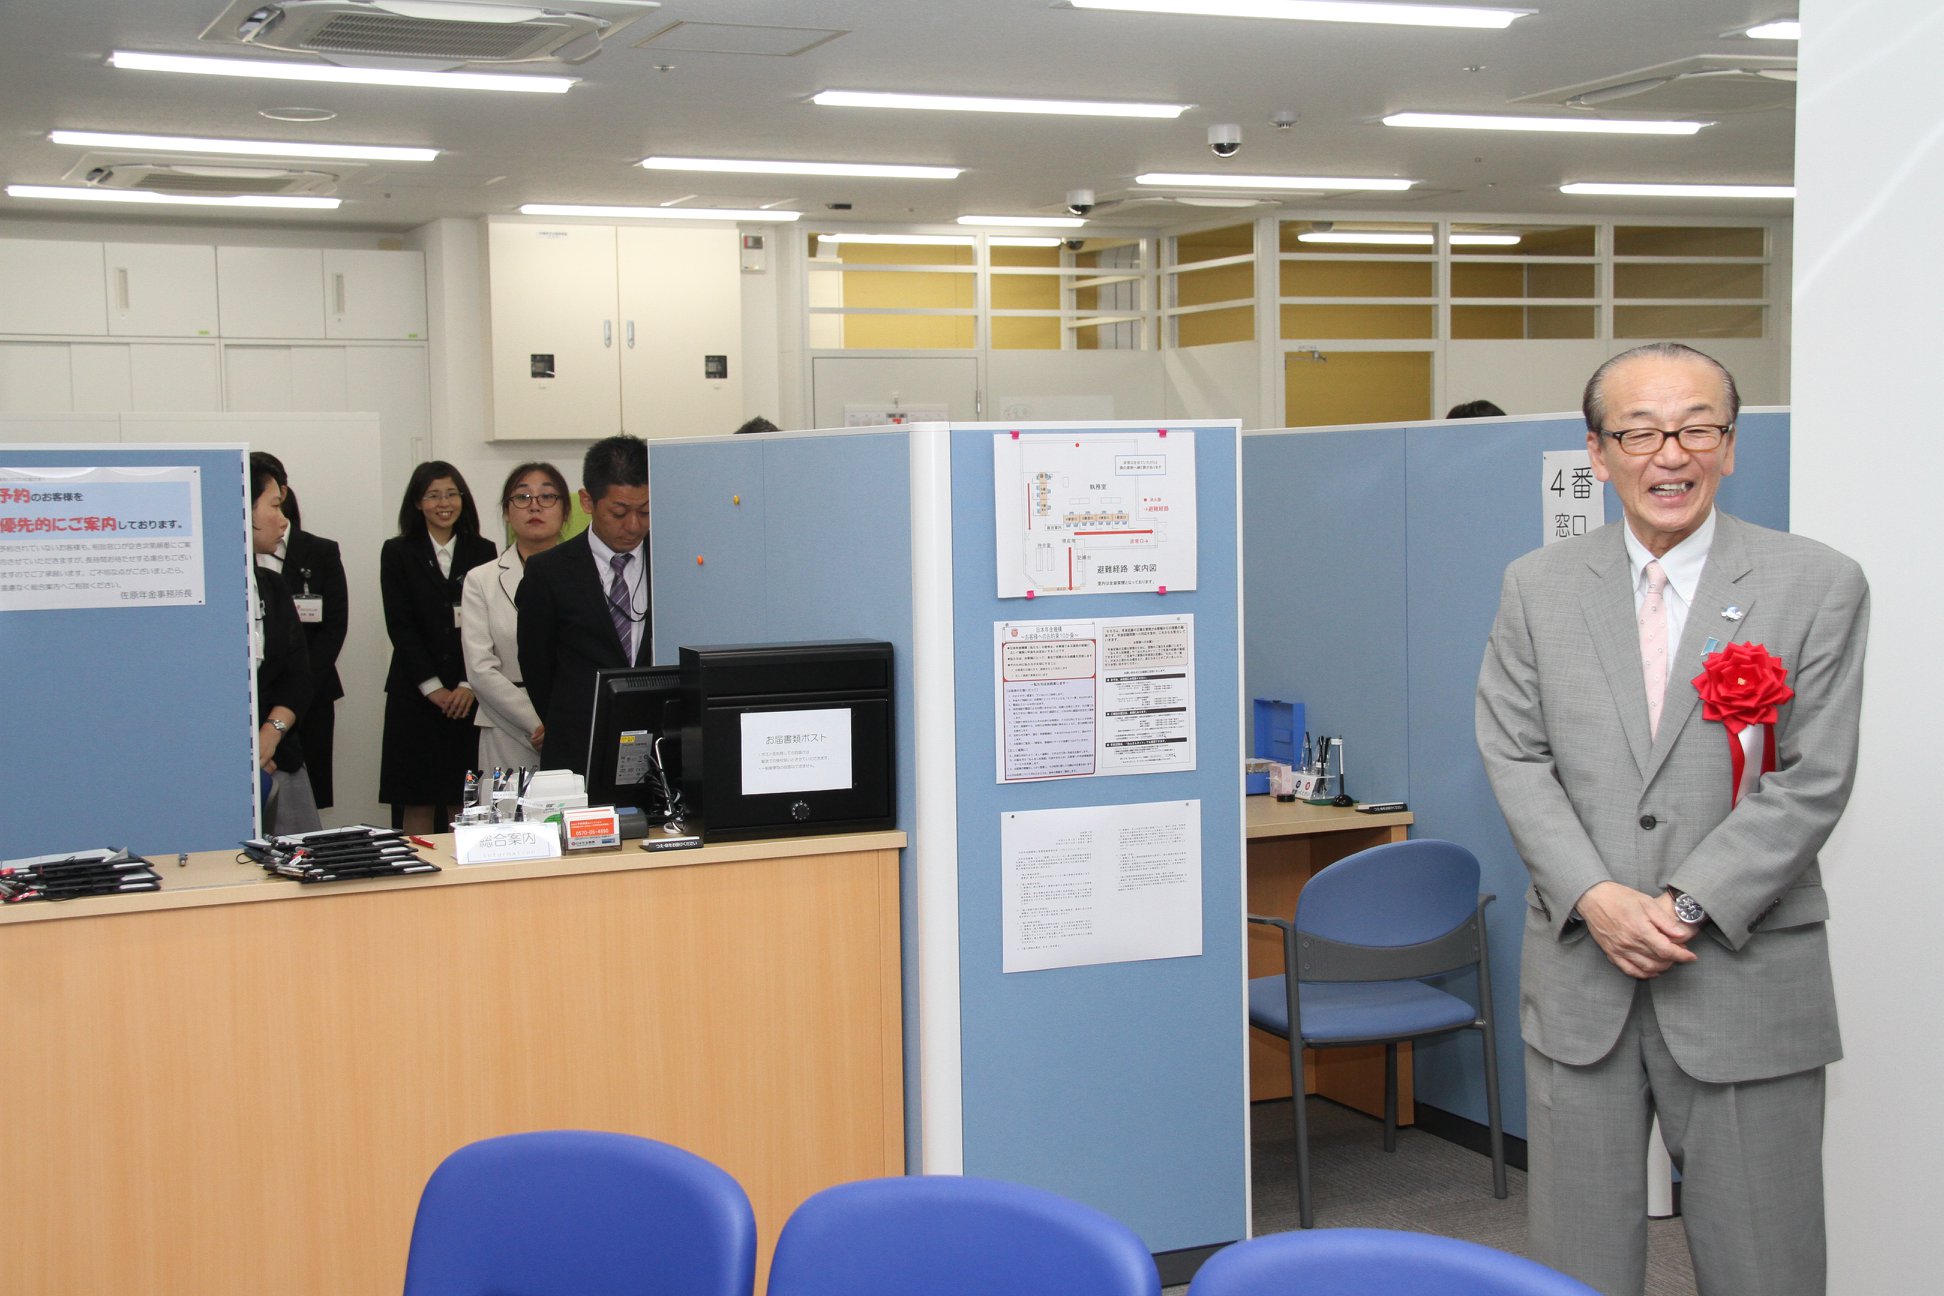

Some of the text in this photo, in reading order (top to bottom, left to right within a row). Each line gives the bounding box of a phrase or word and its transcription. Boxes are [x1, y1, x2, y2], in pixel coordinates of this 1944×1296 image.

[1550, 467, 1593, 499] 4番
[1555, 513, 1587, 537] 窓口
[1097, 563, 1157, 574] 避難経路 案内図
[120, 589, 192, 600] 佐原年金事務所長
[765, 733, 827, 745] お届書類ポスト
[479, 832, 537, 849] 総合案内
